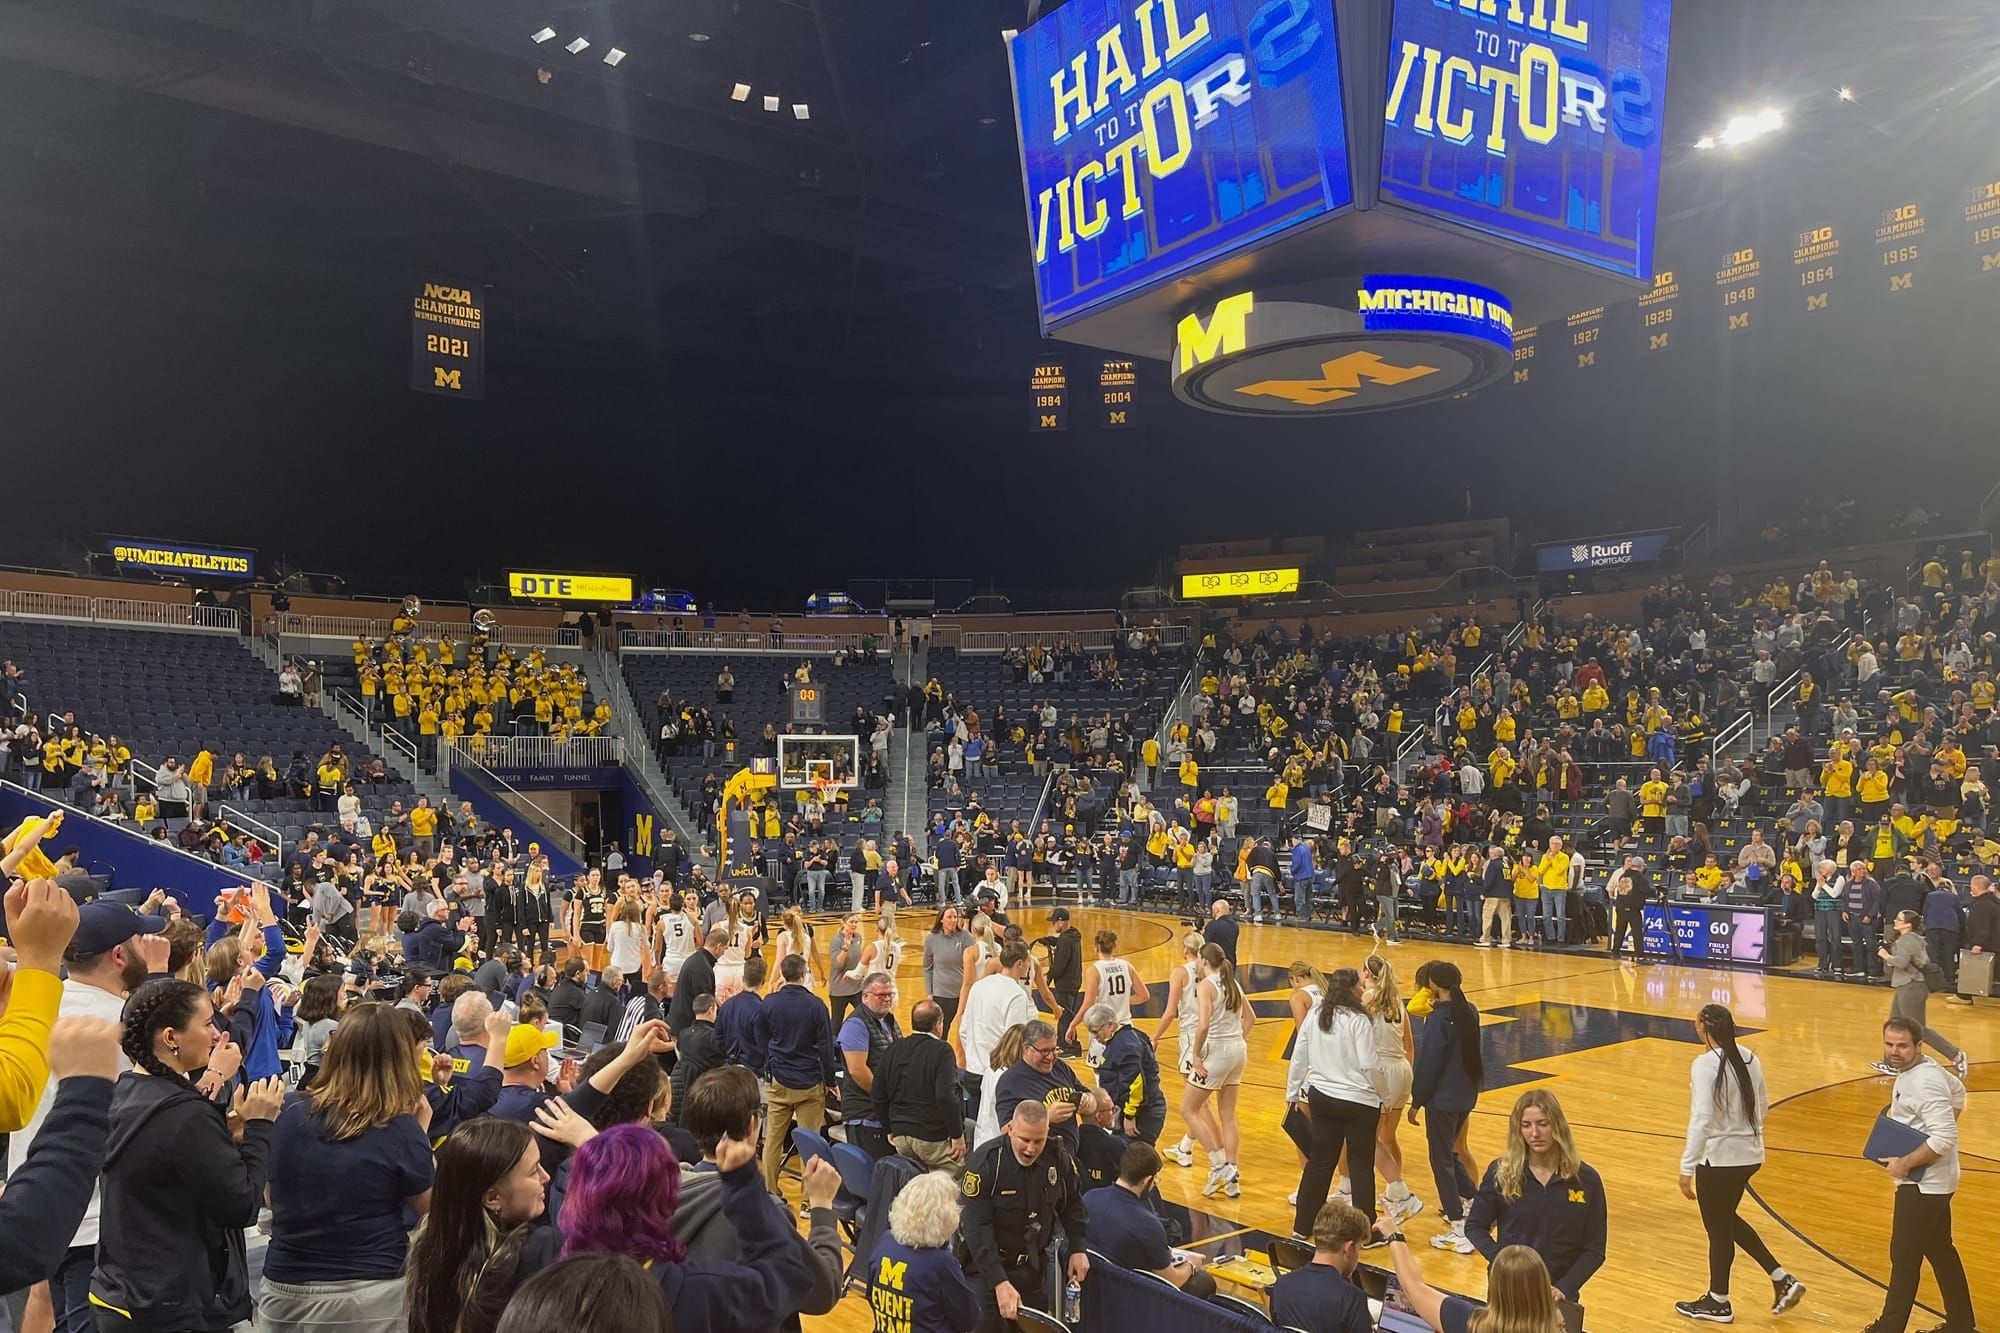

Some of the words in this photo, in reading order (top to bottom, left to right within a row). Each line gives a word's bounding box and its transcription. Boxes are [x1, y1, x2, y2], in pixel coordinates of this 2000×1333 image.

[1435, 0, 1587, 44] AIL
[1475, 29, 1499, 58] TO
[1050, 0, 1211, 144] HAIL
[1094, 116, 1119, 147] TO
[1965, 198, 2000, 216] CHAMPI
[1876, 218, 1925, 238] CHAMPIONS
[1974, 226, 2000, 244] 196
[1794, 240, 1840, 258] CHAMPIONS
[1884, 245, 1918, 266] 1965
[1654, 272, 1673, 288] 1G
[1716, 262, 1760, 280] CHAMPIONS
[1801, 266, 1834, 286] 1964
[1890, 272, 1912, 292] M
[424, 282, 472, 305] NCAA
[1724, 287, 1756, 306] 1948
[1808, 293, 1828, 312] M
[414, 297, 481, 320] CHAMPIONS
[1358, 288, 1485, 320] MICHIGAN
[414, 310, 442, 323] WOMEN'S
[443, 316, 480, 330] GYMNASTICS
[1644, 309, 1673, 327] 1929
[1729, 312, 1748, 330] M
[1177, 291, 1254, 374] M
[1574, 328, 1600, 346] 1927
[1650, 333, 1668, 350] M
[426, 334, 469, 358] 2021
[1512, 346, 1534, 361] 926
[1578, 352, 1595, 368] M
[434, 366, 462, 390] M
[1034, 366, 1063, 376] NIT
[1100, 372, 1135, 382] CHAMPIONS
[1513, 369, 1529, 384] M
[1032, 376, 1066, 386] CHAMPIONS
[1036, 395, 1061, 408] 1984
[1104, 392, 1132, 404] 2004
[1040, 414, 1057, 428] M
[1110, 411, 1126, 424] M
[1591, 541, 1632, 558] Ruoff
[114, 546, 248, 572] @UMICHATHLETICS
[1591, 556, 1632, 567] MORTGAGE
[521, 577, 572, 596] DTE
[636, 813, 654, 857] M
[732, 868, 754, 877] UMCU
[590, 903, 604, 914] 32
[674, 923, 684, 938] 5
[1678, 928, 1694, 938] 0.0
[1710, 922, 1729, 936] 60
[1108, 974, 1126, 996] 10
[1568, 1189, 1586, 1203] M
[878, 1256, 908, 1291] M
[872, 1286, 914, 1320] EVENT
[875, 1308, 912, 1333] TEAM
